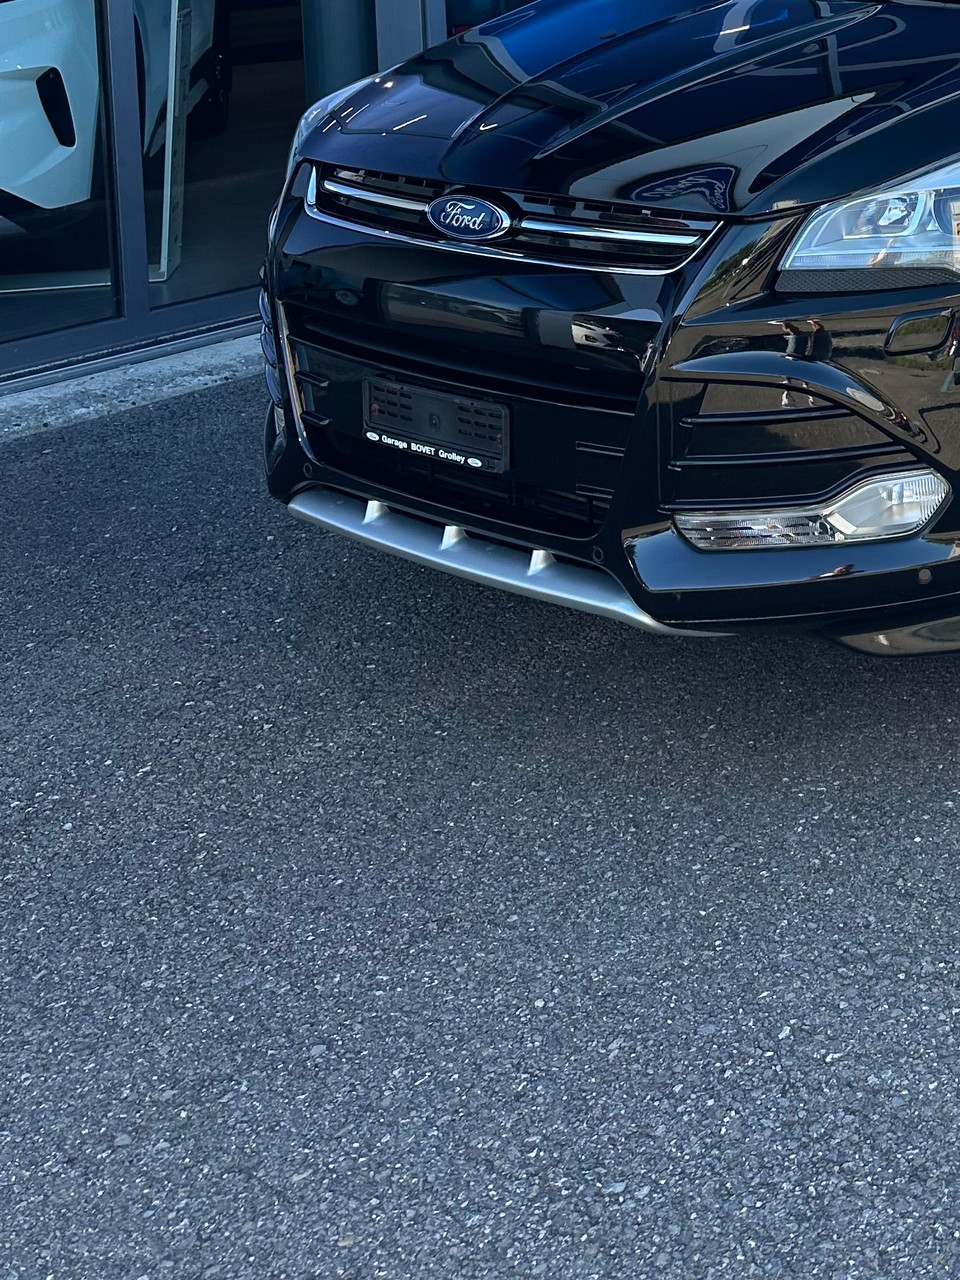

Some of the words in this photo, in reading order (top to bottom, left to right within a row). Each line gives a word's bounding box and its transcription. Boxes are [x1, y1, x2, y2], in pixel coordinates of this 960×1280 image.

[440, 200, 486, 230] Ford
[381, 434, 408, 449] Garage
[410, 442, 436, 456] BOVET
[438, 449, 466, 465] Grolley
